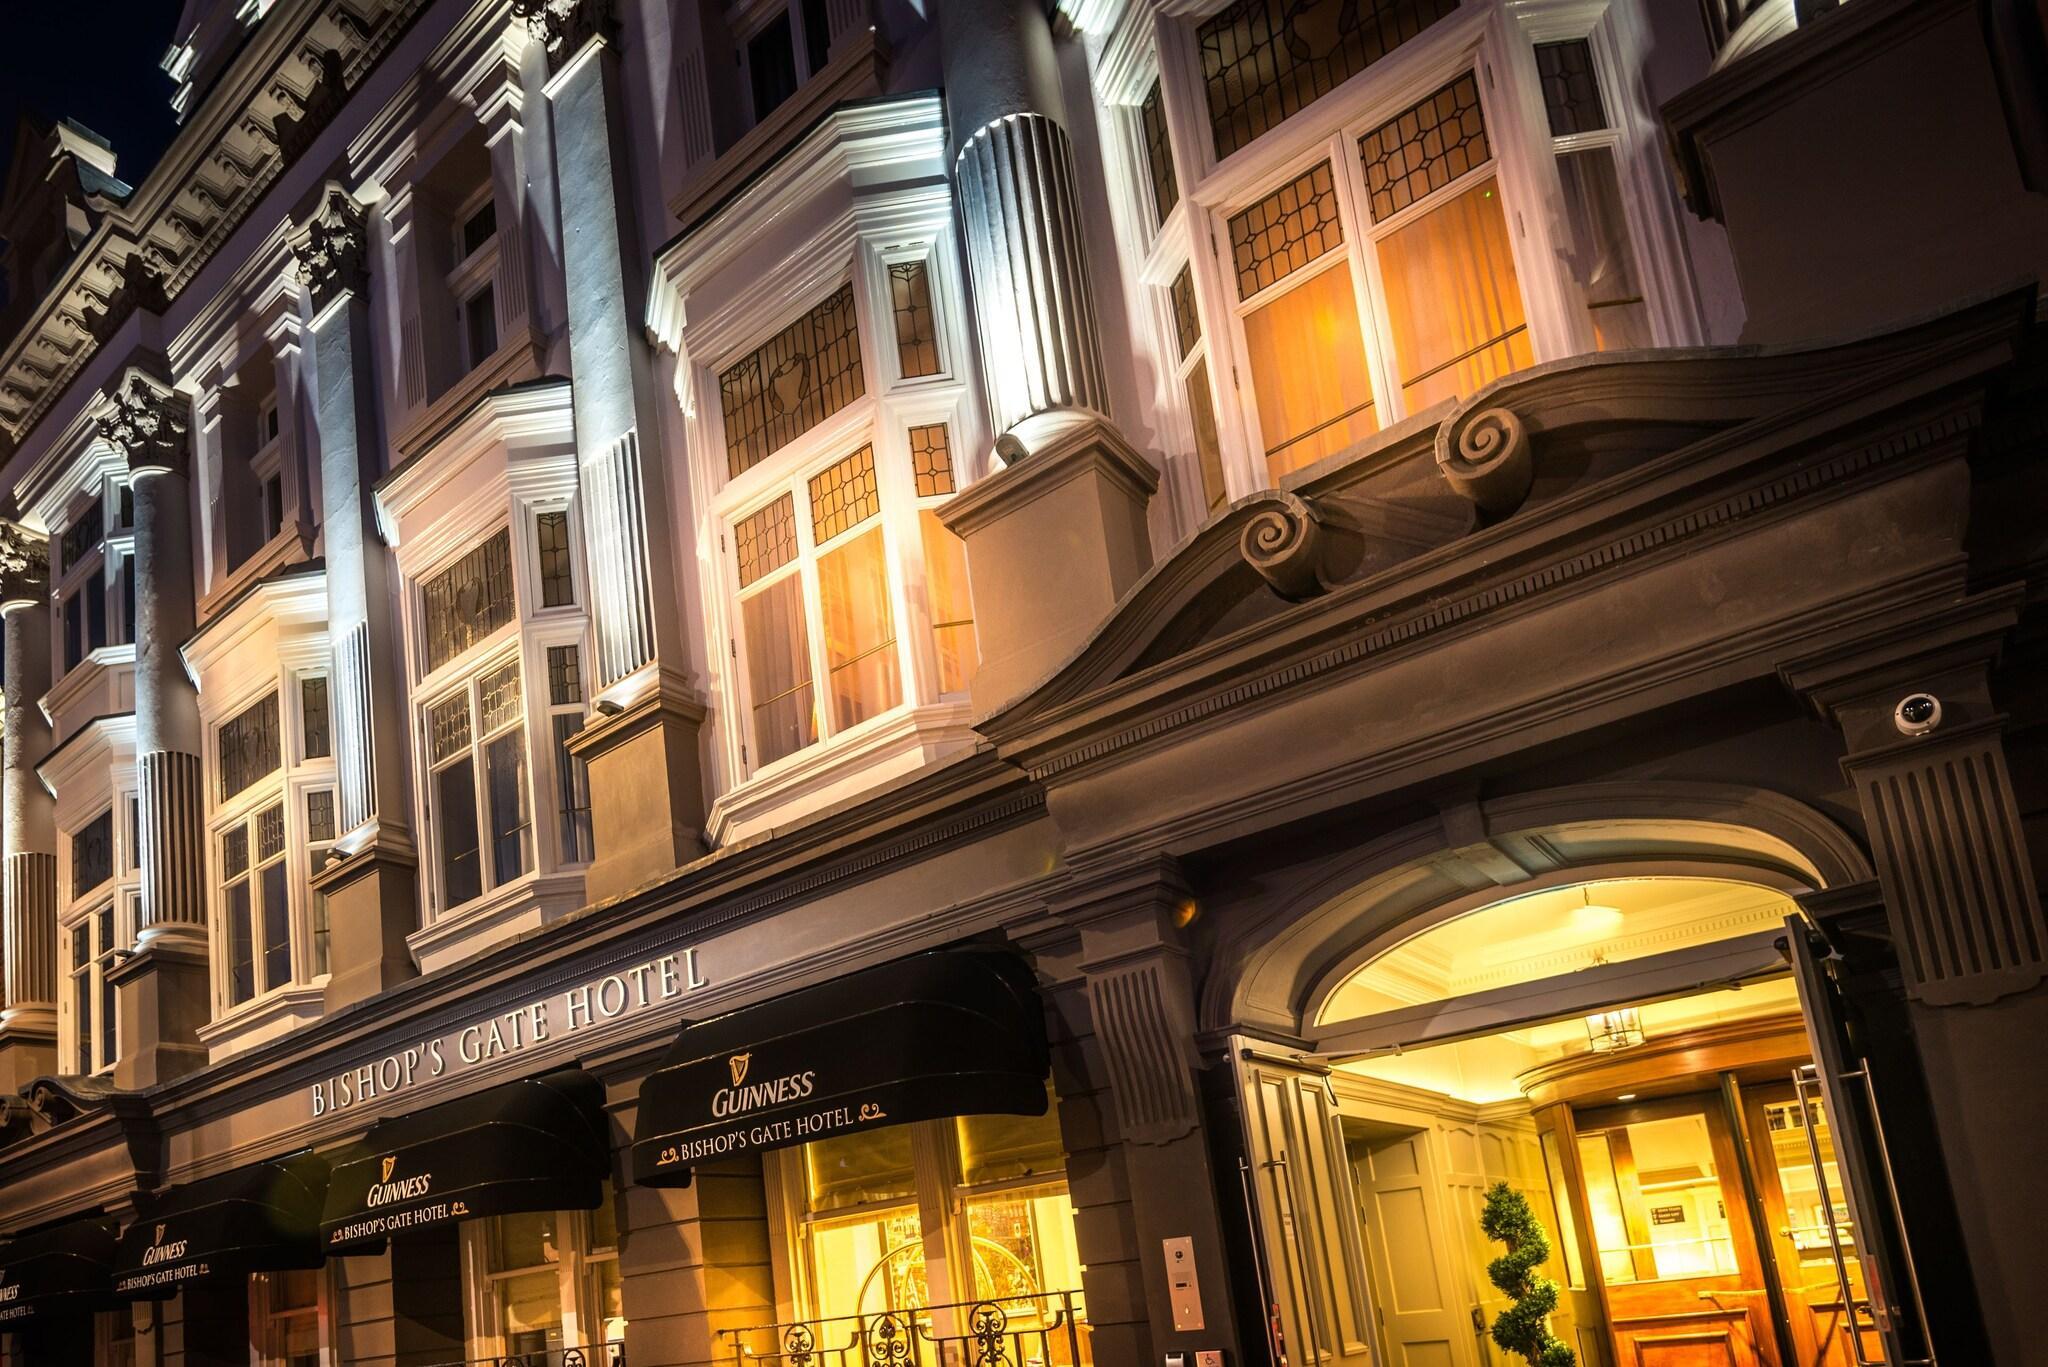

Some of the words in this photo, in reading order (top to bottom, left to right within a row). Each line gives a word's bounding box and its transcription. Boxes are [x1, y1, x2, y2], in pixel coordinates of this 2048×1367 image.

[311, 1038, 445, 1117] BISHOP'S
[459, 1001, 550, 1065] GATE
[566, 947, 708, 1031] HOTEL
[711, 1070, 815, 1118] GUINNESS
[680, 1130, 747, 1161] BISHOP'S
[750, 1120, 792, 1145] GATE
[797, 1107, 854, 1135] HOTEL
[367, 1173, 432, 1208] GUINNESS
[344, 1217, 385, 1240] BISHOP'S
[386, 1211, 412, 1230] GATE
[414, 1203, 449, 1224] HOTEL
[142, 1239, 188, 1266] GUINNESS
[127, 1273, 156, 1290] BISHOP'S
[155, 1269, 173, 1284] GATE
[174, 1264, 198, 1281] HOTEL
